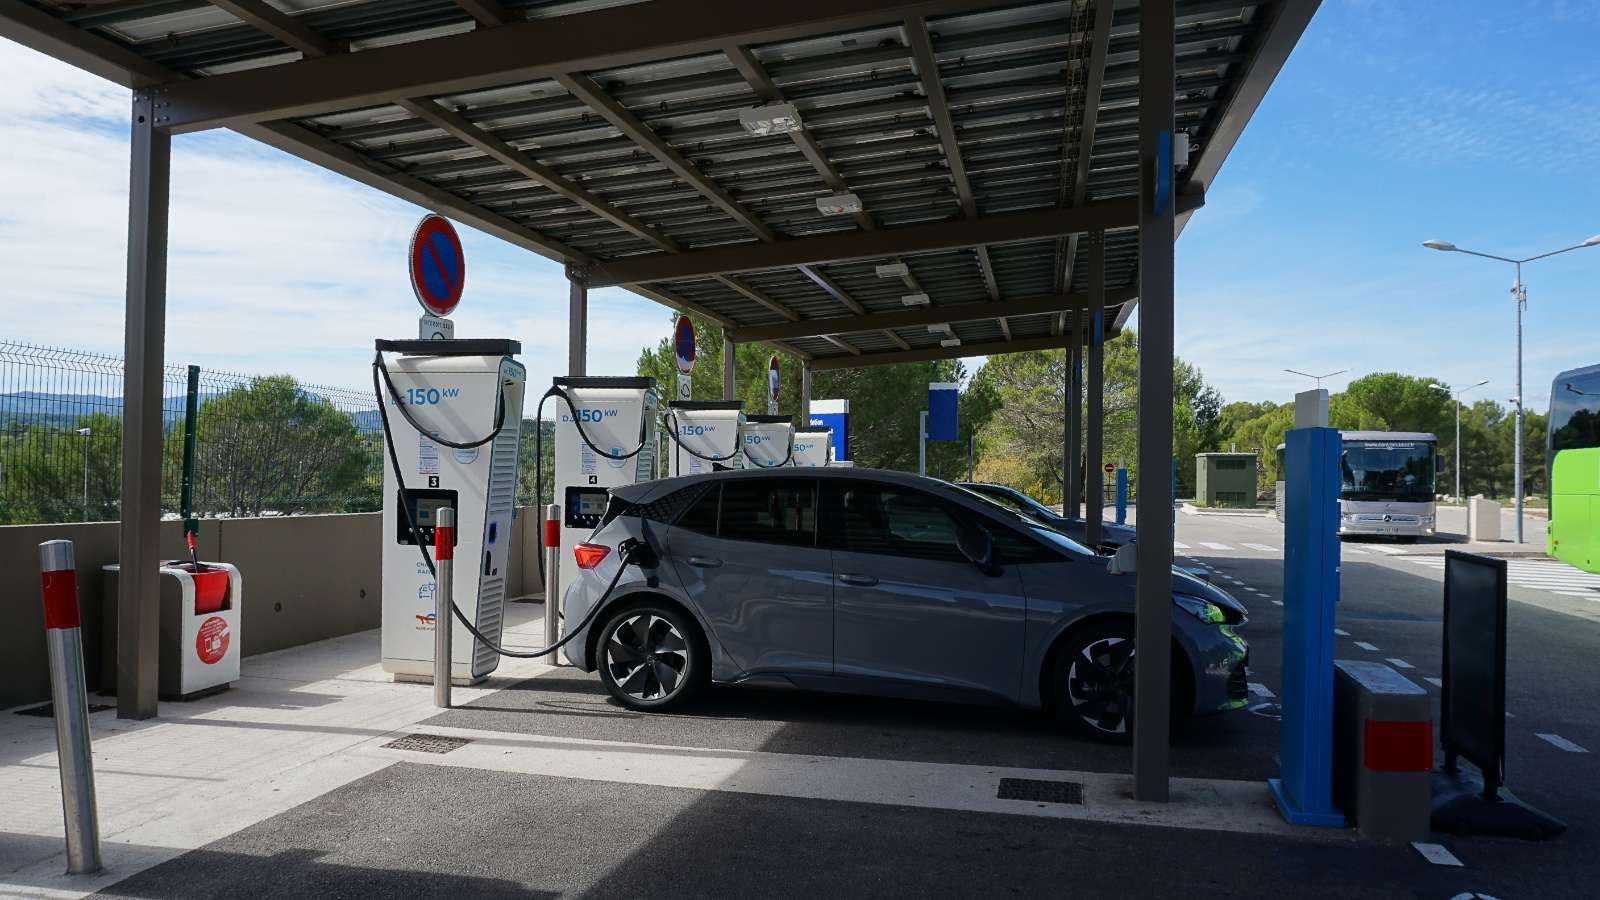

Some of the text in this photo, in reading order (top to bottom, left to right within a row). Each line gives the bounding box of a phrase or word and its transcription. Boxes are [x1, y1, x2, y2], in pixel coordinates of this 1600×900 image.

[407, 388, 440, 405] 150
[442, 388, 459, 398] kW
[576, 409, 603, 422] 150
[604, 409, 618, 417] kW
[681, 426, 704, 436] 150
[430, 478, 437, 487] 3
[590, 476, 596, 484] 4
